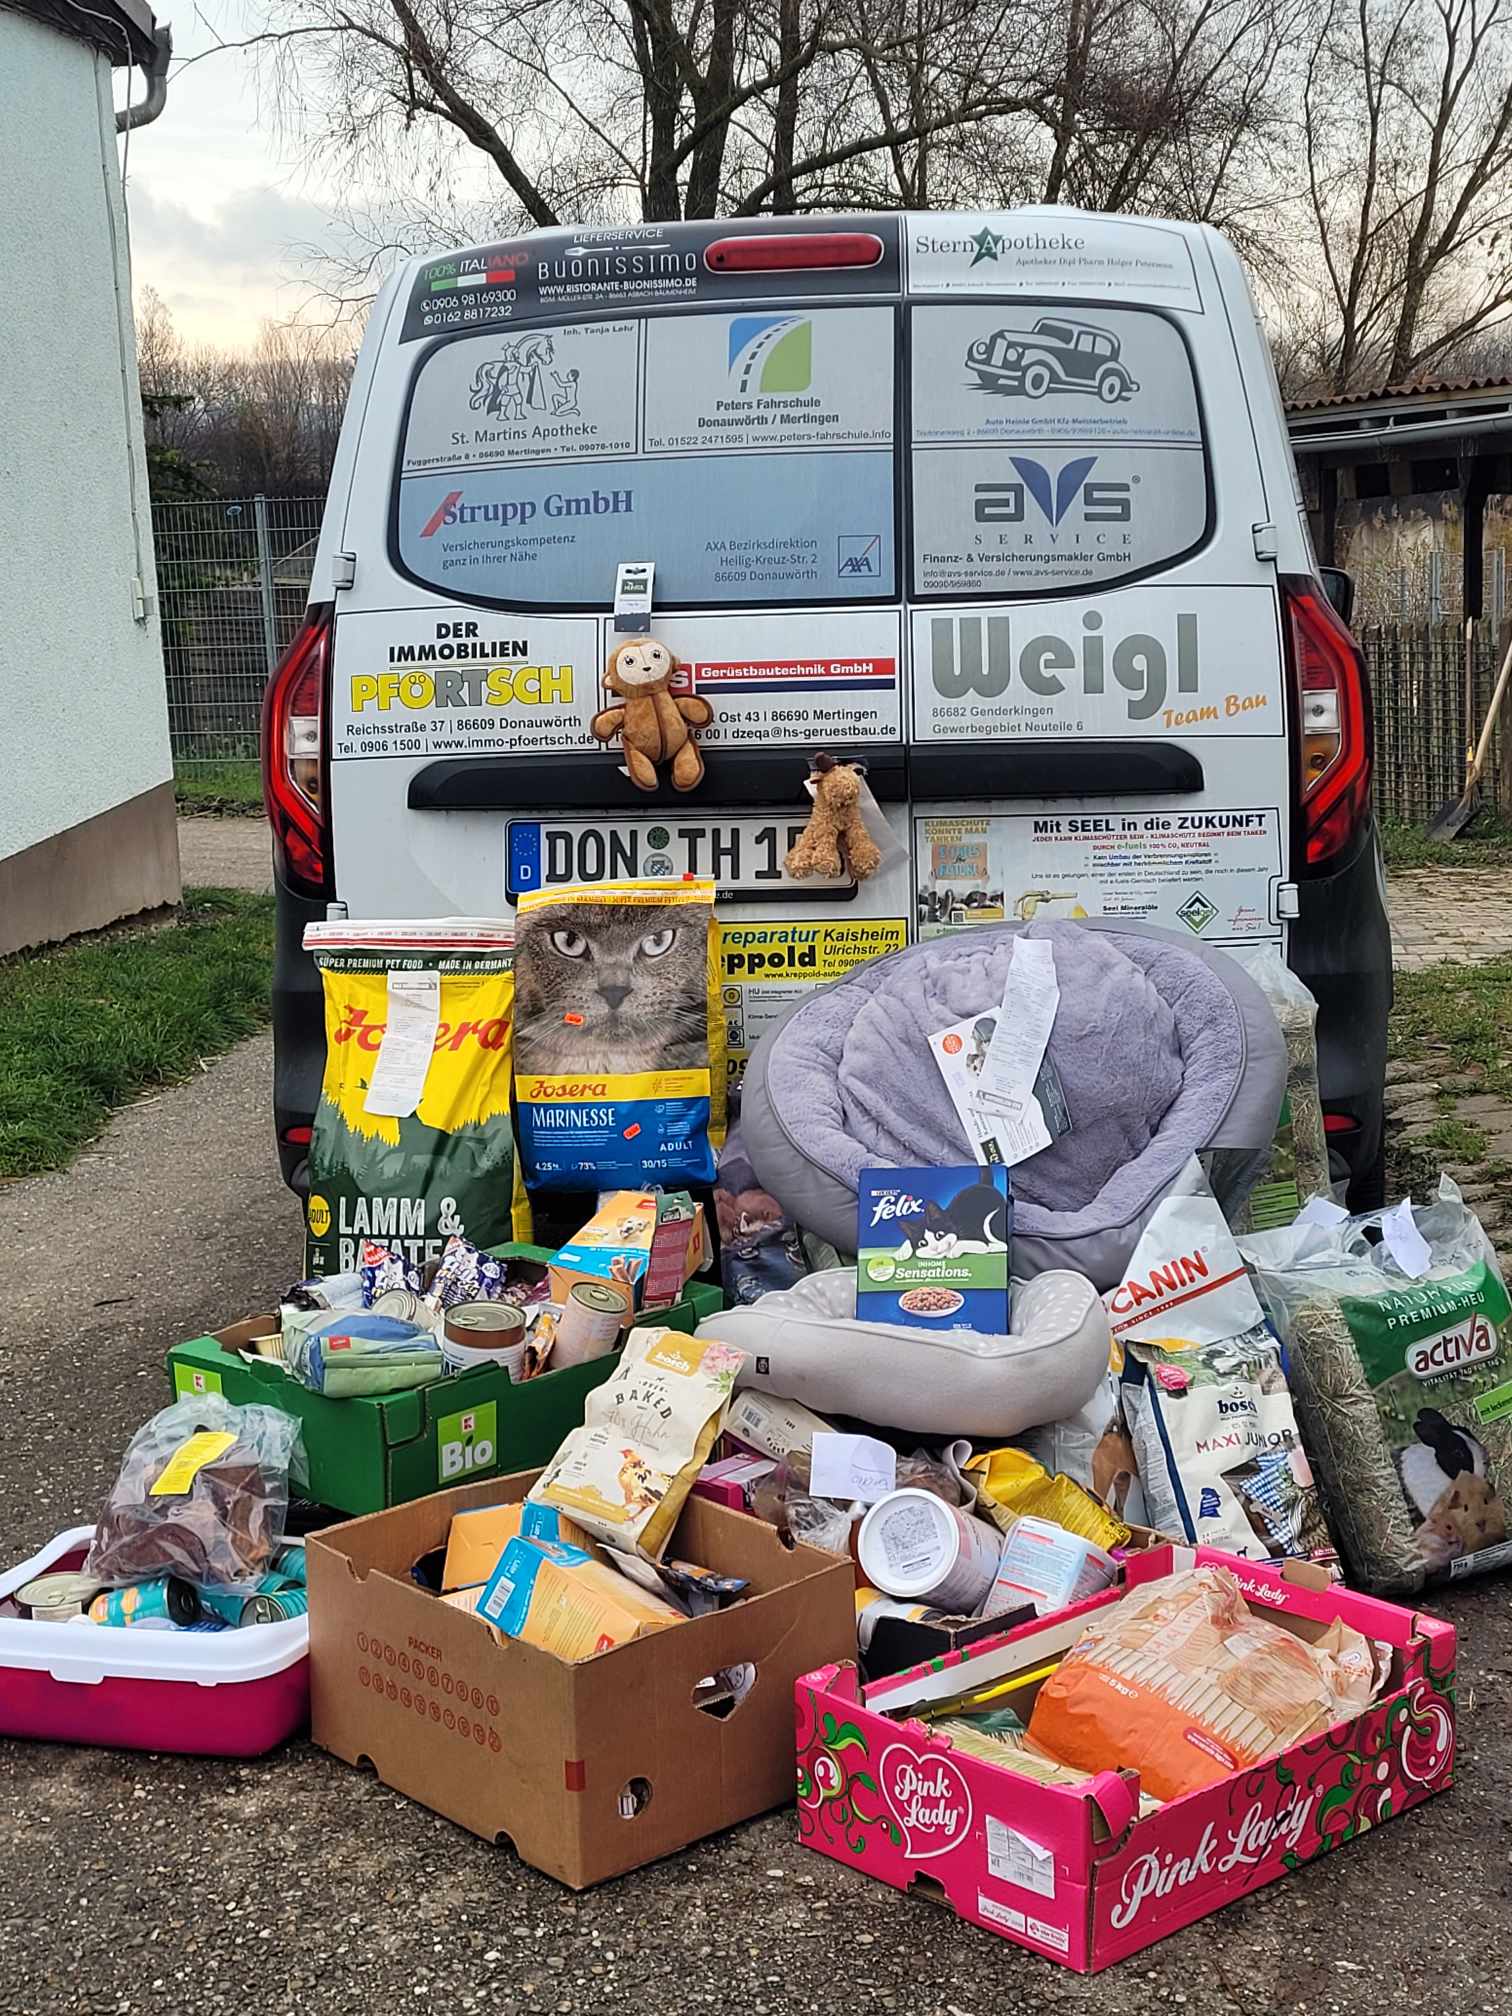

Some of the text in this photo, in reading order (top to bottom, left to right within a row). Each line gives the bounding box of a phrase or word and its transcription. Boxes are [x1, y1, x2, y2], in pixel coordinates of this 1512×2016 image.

[574, 228, 664, 244] LIEFERSERVICE
[916, 236, 974, 254] Stern
[424, 253, 529, 281] 100% ITALIANO
[538, 252, 697, 280] BUONISSIMO
[432, 289, 517, 312] 0906 98169300
[434, 305, 512, 325] 0162 8817232
[716, 397, 821, 410] Peters Fahrschule
[698, 412, 839, 428] Donauwörth Mertingen
[451, 422, 598, 446] St. Martins Apotheke
[648, 438, 666, 448] Tel.
[668, 436, 698, 446] 01522
[752, 430, 891, 444] www.peters-fahrschule.info
[507, 446, 552, 456] Mertingen
[443, 490, 634, 526] Strupp GmbH
[442, 534, 576, 552] Versicherungskompetenz
[705, 538, 817, 552] AXA Bezirksdirektion
[974, 534, 1132, 545] SERVICE
[442, 550, 538, 570] ganz in Ihrer Nähe
[720, 554, 817, 568] Heilig-Kreuz-Str. 2
[839, 556, 873, 573] AXA
[922, 552, 1131, 564] Finanz- & Versicherungsmakler GmbH
[714, 569, 818, 582] 86609 Donauwörth
[436, 622, 479, 640] DER
[389, 640, 528, 663] IMMOBILIEN
[701, 663, 874, 678] Gerüstbautechnik GmbH
[930, 610, 1199, 720] Weigl
[351, 665, 574, 712] PFÖRTSCH
[719, 709, 878, 724] Ost 43 86690 Mertingen
[932, 705, 1054, 718] 86682 Genderkingen
[1162, 693, 1267, 728] Team Bau
[346, 716, 582, 736] Reichsstraße 37 86609 Donauwörth
[706, 725, 896, 740] 00 dzeqa@hs-geruestbau.de
[932, 722, 1022, 735] Gewerbegebiet
[1025, 722, 1074, 732] Neuteile
[338, 734, 594, 754] Tel. 0906 1500 www.immo-pfoertsch.de
[1033, 814, 1266, 834] Mit SEEL in die ZUKUNFT
[546, 828, 638, 882] DON
[678, 828, 740, 880] TH
[519, 866, 532, 880] D
[722, 928, 899, 948] reparatur Kaisheim
[824, 944, 880, 956] Ulrichstr.
[319, 957, 344, 968] SUPER
[347, 958, 383, 968] PREMIUM
[386, 959, 400, 968] PET
[402, 959, 422, 970] FOOD
[438, 960, 460, 970] MADE
[462, 960, 472, 969] IN
[822, 959, 836, 968] Tel
[530, 1080, 608, 1098] Josera
[532, 1107, 616, 1128] MARINESSE
[660, 1141, 692, 1152] ADULT
[642, 1160, 667, 1168] 30/15
[338, 1196, 464, 1236] LAMM &
[1110, 1250, 1209, 1314] CANIN
[1388, 1292, 1485, 1330] PREMIUM-HEU
[1415, 1312, 1490, 1372] activa
[616, 1390, 672, 1418] BAKED
[1196, 1433, 1241, 1454] MAXI
[442, 1437, 492, 1478] Bio
[1255, 1584, 1286, 1604] Lady
[408, 1636, 442, 1661] PACKER
[895, 1764, 952, 1800] Pink
[904, 1797, 958, 1836] Lady
[1111, 1822, 1218, 1928] Pink
[1218, 1785, 1314, 1872] Lady
